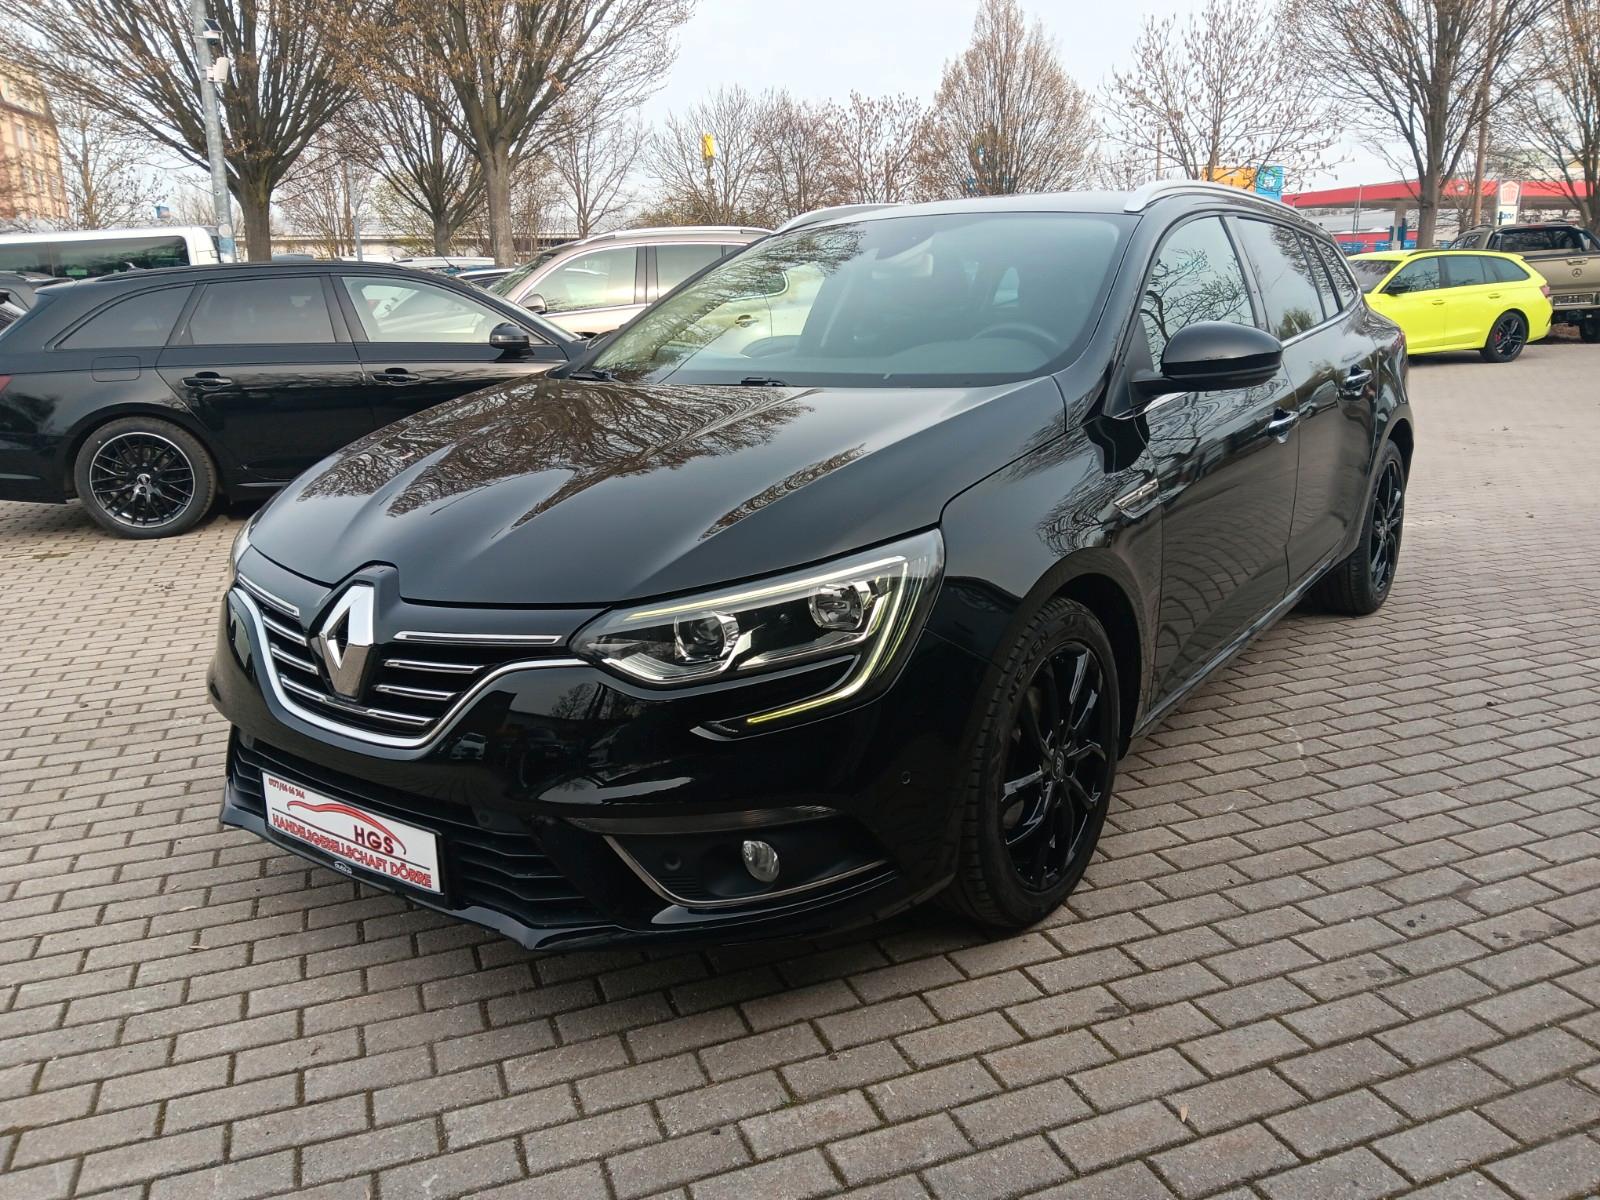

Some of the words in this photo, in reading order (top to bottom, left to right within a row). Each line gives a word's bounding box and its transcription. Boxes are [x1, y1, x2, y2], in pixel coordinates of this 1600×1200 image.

[1008, 630, 1048, 704] NEXEN
[272, 813, 387, 872] HANDELSGESELLSCHAFT
[390, 863, 432, 888] DÖRRE
[354, 825, 394, 855] HGS
